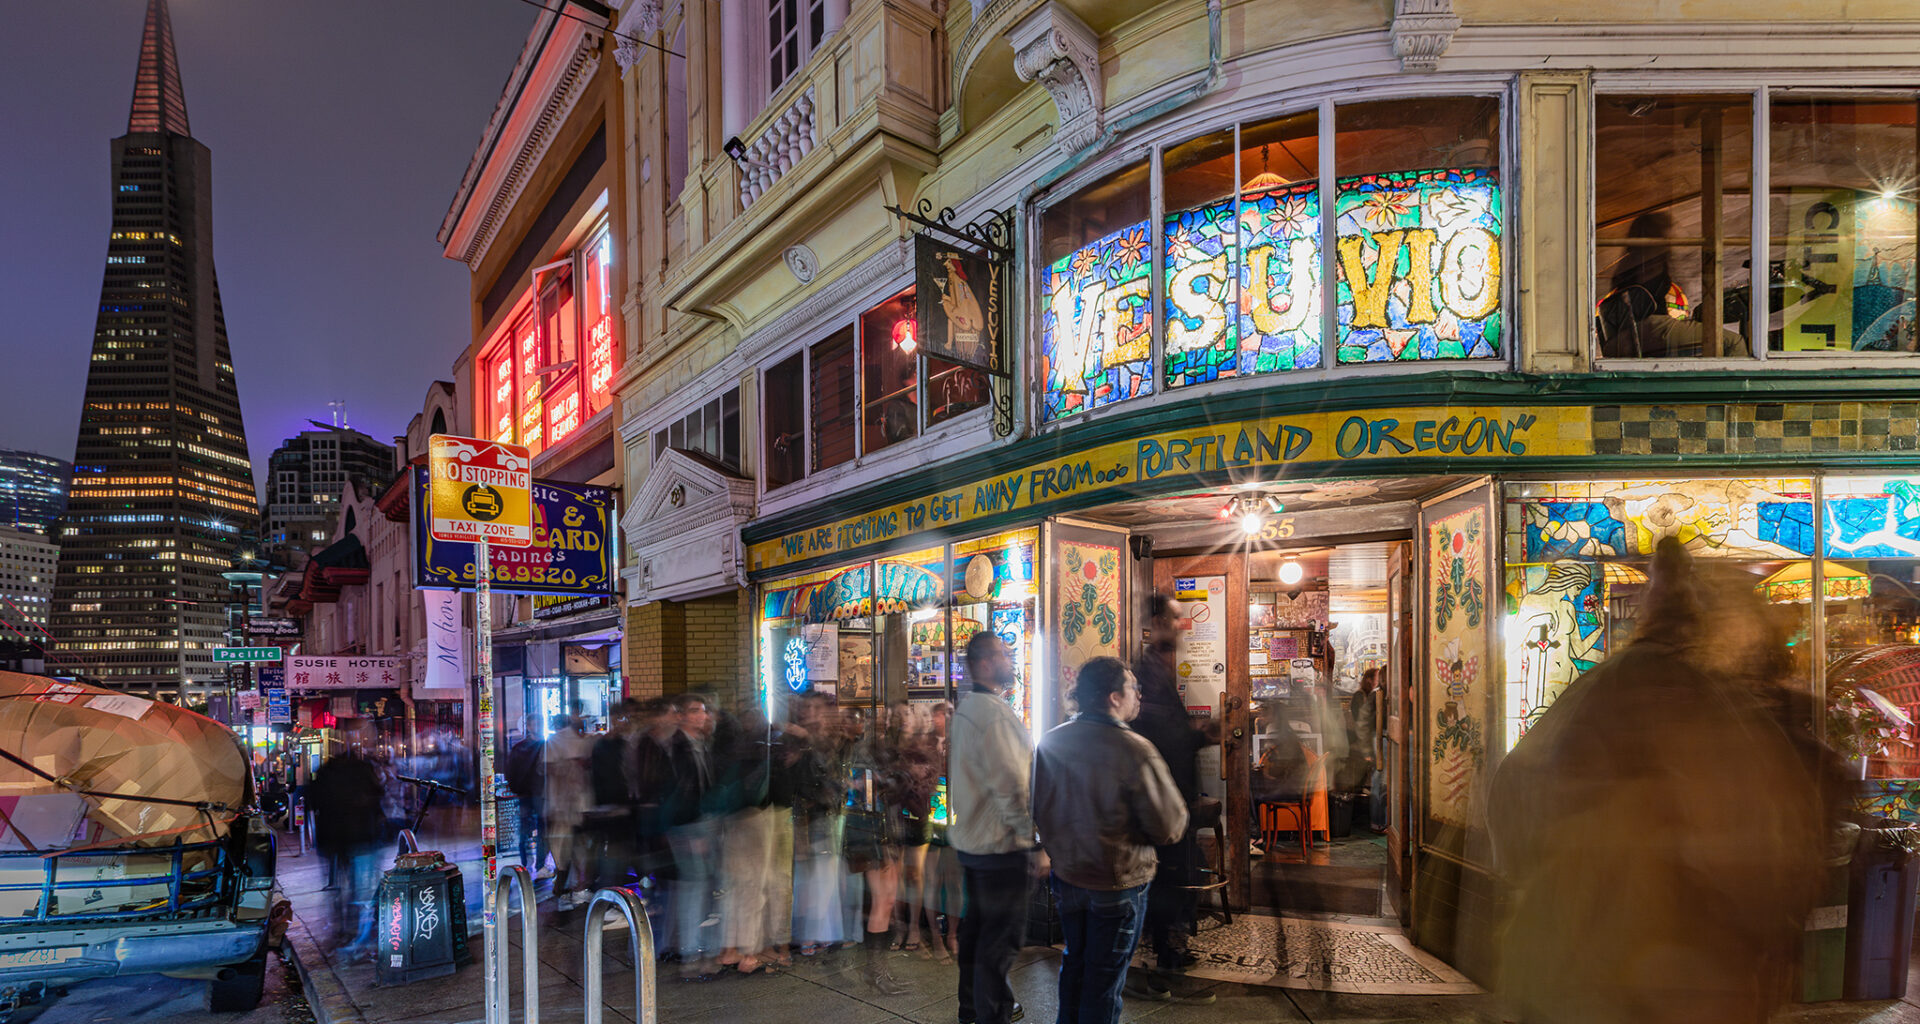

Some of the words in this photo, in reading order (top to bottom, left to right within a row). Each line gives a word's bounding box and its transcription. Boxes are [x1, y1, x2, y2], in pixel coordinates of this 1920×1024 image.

[987, 262, 1000, 371] VESUVIO
[1050, 226, 1502, 397] VESUVIO
[434, 461, 460, 480] NO
[466, 467, 525, 488] STOPPING
[808, 527, 833, 551] ARE
[904, 503, 926, 531] TO
[930, 493, 963, 522] GET
[973, 474, 1023, 515] AWAY
[1136, 424, 1313, 481] PORTLAND
[449, 521, 477, 532] TAXI
[484, 524, 515, 536] ZONE
[532, 526, 600, 551] CARD
[475, 549, 566, 563] EADINGS
[463, 563, 576, 584] 96.9320
[221, 650, 274, 659] Pacific
[349, 660, 394, 668] HOTEL
